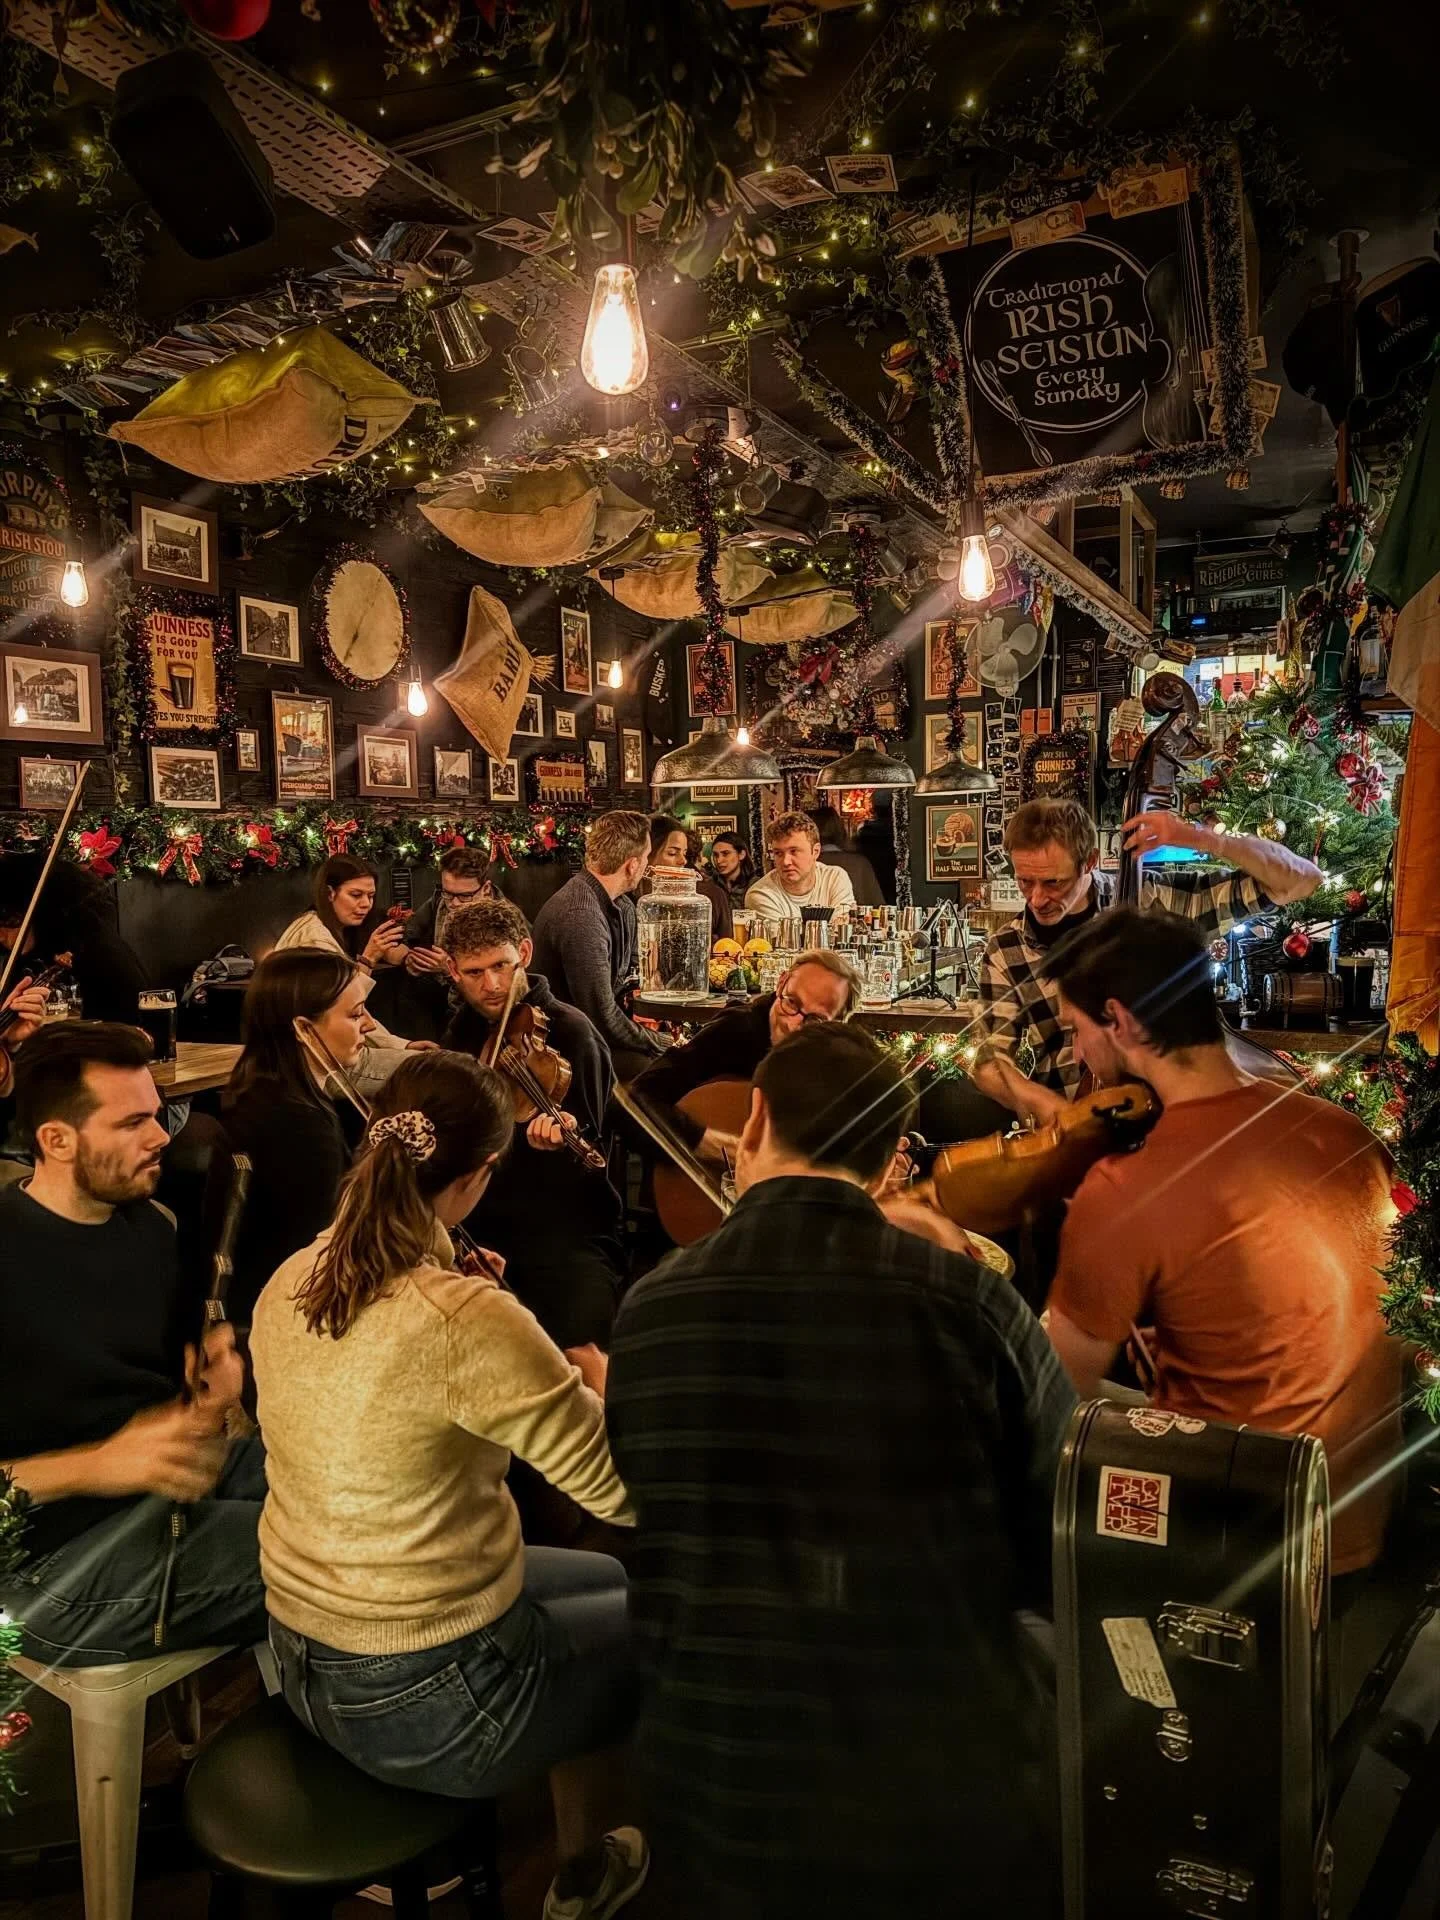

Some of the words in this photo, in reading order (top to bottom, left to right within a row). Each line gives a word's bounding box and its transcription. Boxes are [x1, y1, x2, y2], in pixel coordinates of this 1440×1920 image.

[1010, 188, 1068, 210] GUINSS
[986, 264, 1126, 308] Traditional
[997, 321, 1148, 374] SEISIÚN
[1034, 382, 1121, 406] Sunday
[1200, 562, 1248, 586] REMEDIES
[1246, 568, 1284, 582] CURES
[150, 615, 210, 638] UINNESS
[156, 635, 166, 644] IS
[170, 637, 197, 648] GOOD
[157, 648, 175, 658] FOR
[178, 650, 198, 661] YOU
[169, 713, 184, 722] YOU
[1035, 759, 1077, 772] GUINNESS
[1035, 772, 1060, 783] STOUT
[964, 864, 977, 872] LINE
